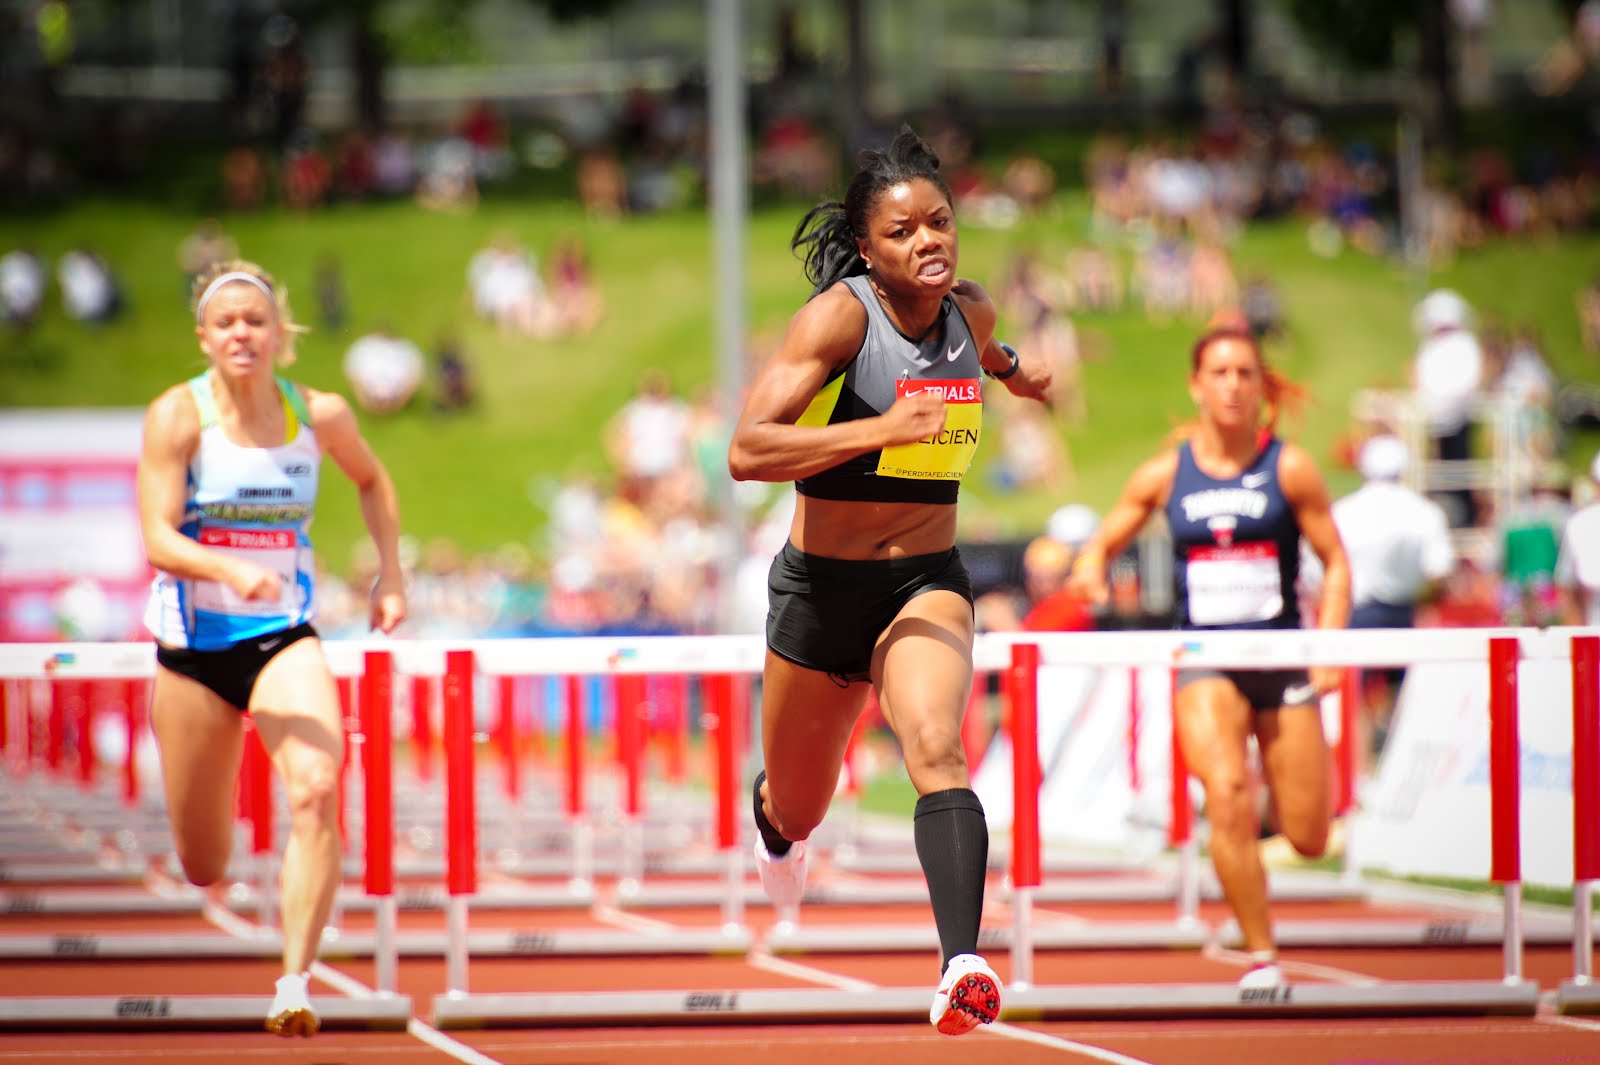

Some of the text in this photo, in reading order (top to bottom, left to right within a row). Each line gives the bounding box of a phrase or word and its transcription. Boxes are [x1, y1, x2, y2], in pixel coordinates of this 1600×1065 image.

[924, 386, 975, 401] TRIALS
[896, 467, 964, 478] @PERDITAFELICIEN
[229, 532, 289, 547] TRIALS
